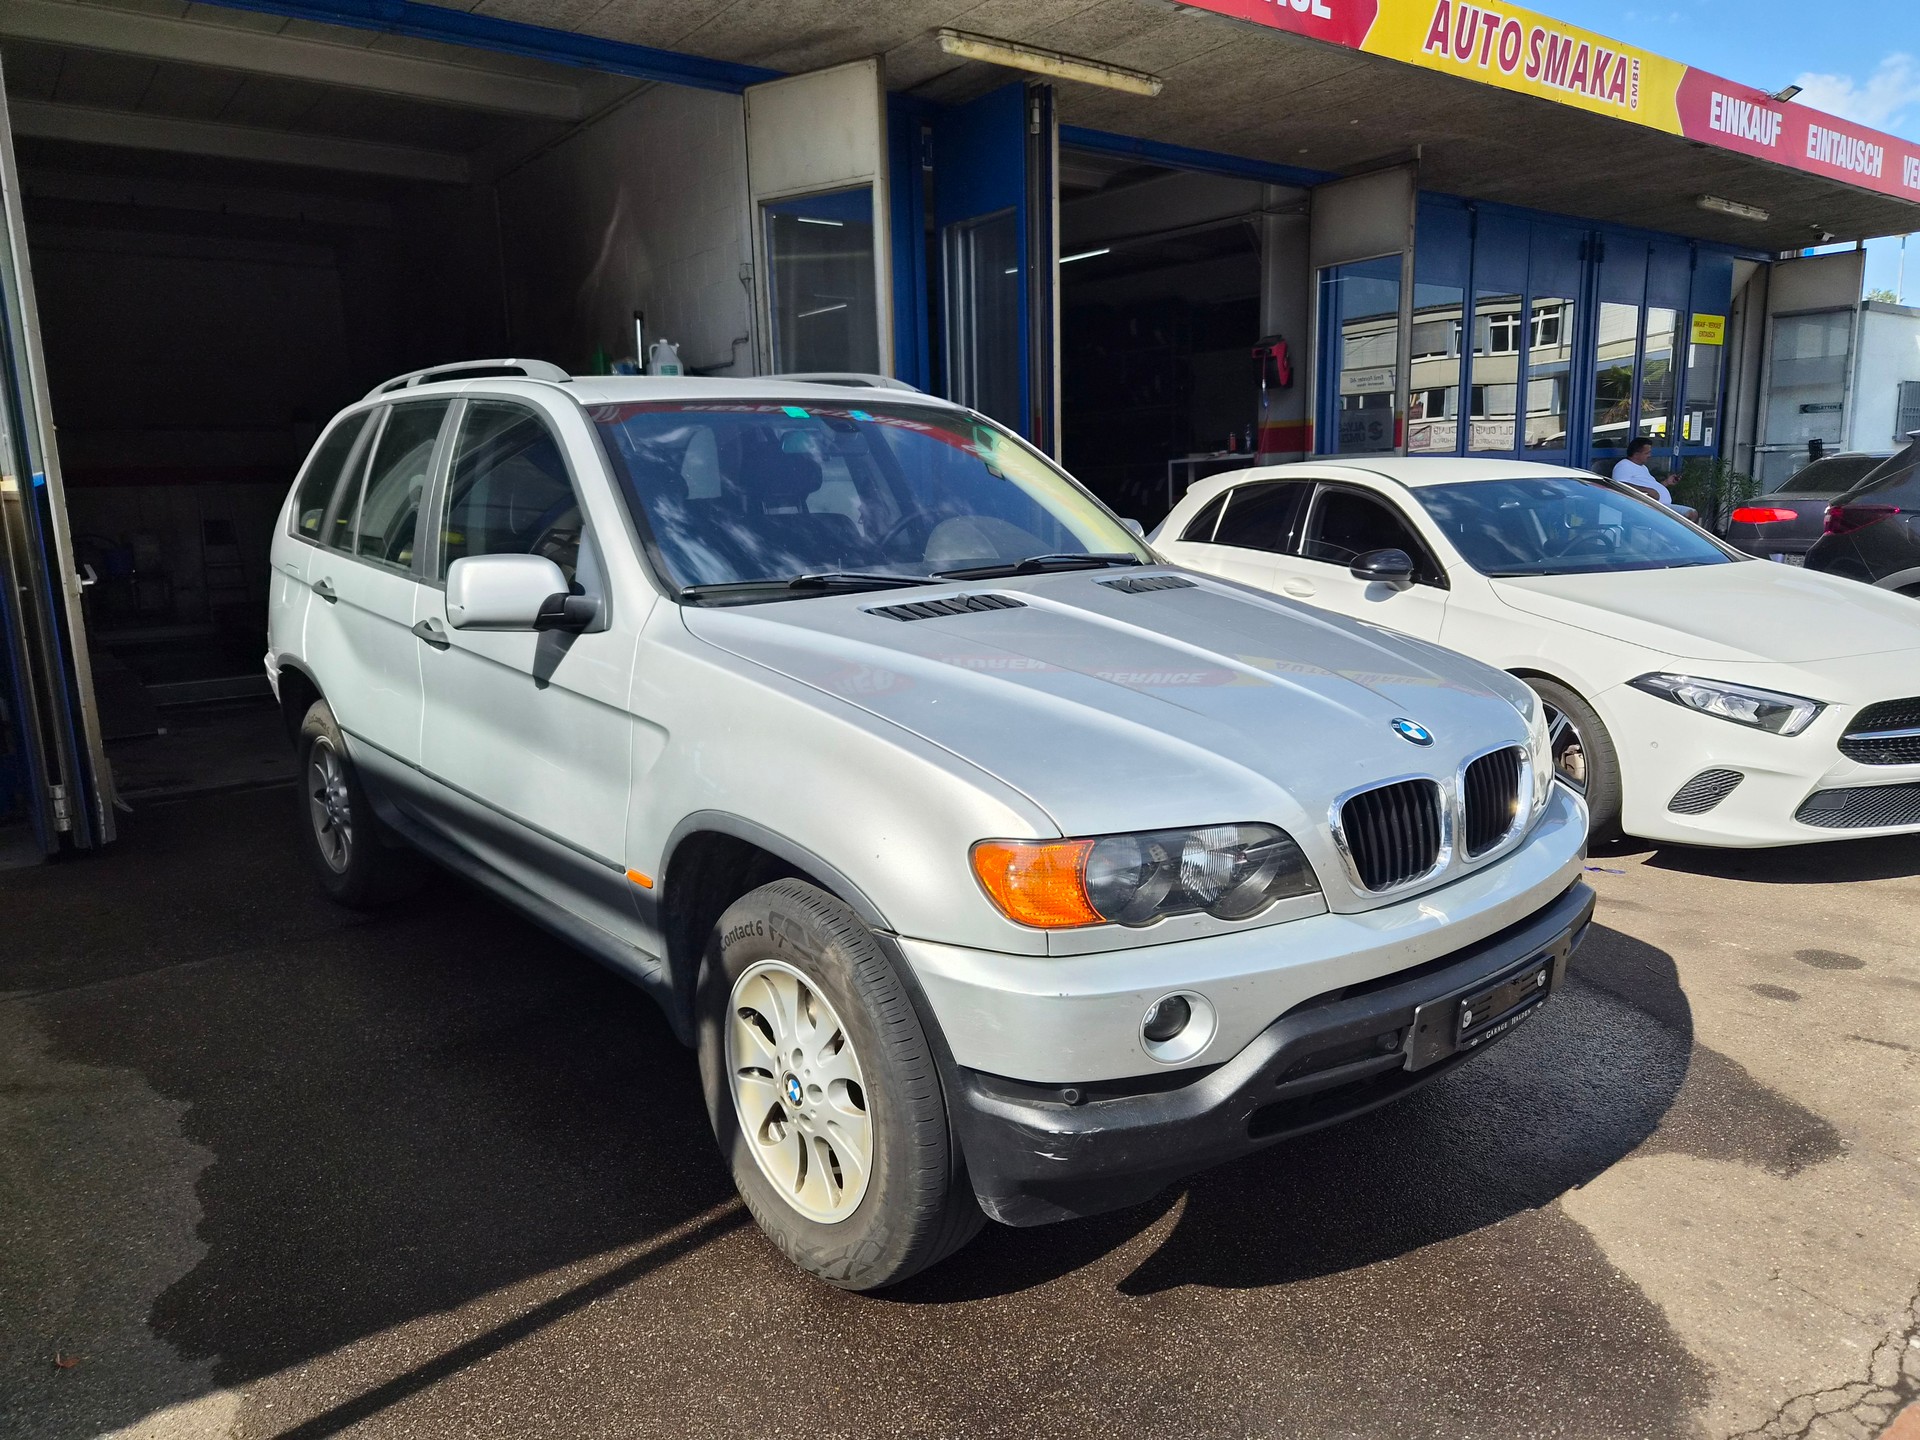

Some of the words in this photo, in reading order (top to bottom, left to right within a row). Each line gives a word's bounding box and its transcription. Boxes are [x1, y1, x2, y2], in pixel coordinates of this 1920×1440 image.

[1423, 0, 1522, 73] AUTO
[1524, 27, 1627, 104] SMAKA
[1631, 59, 1640, 109] GMBH
[1709, 91, 1783, 147] EINKAUF
[1806, 123, 1884, 179] EINTAUSCH
[1903, 154, 1920, 190] VE
[756, 920, 764, 936] 6
[1486, 1022, 1508, 1039] GARAGE
